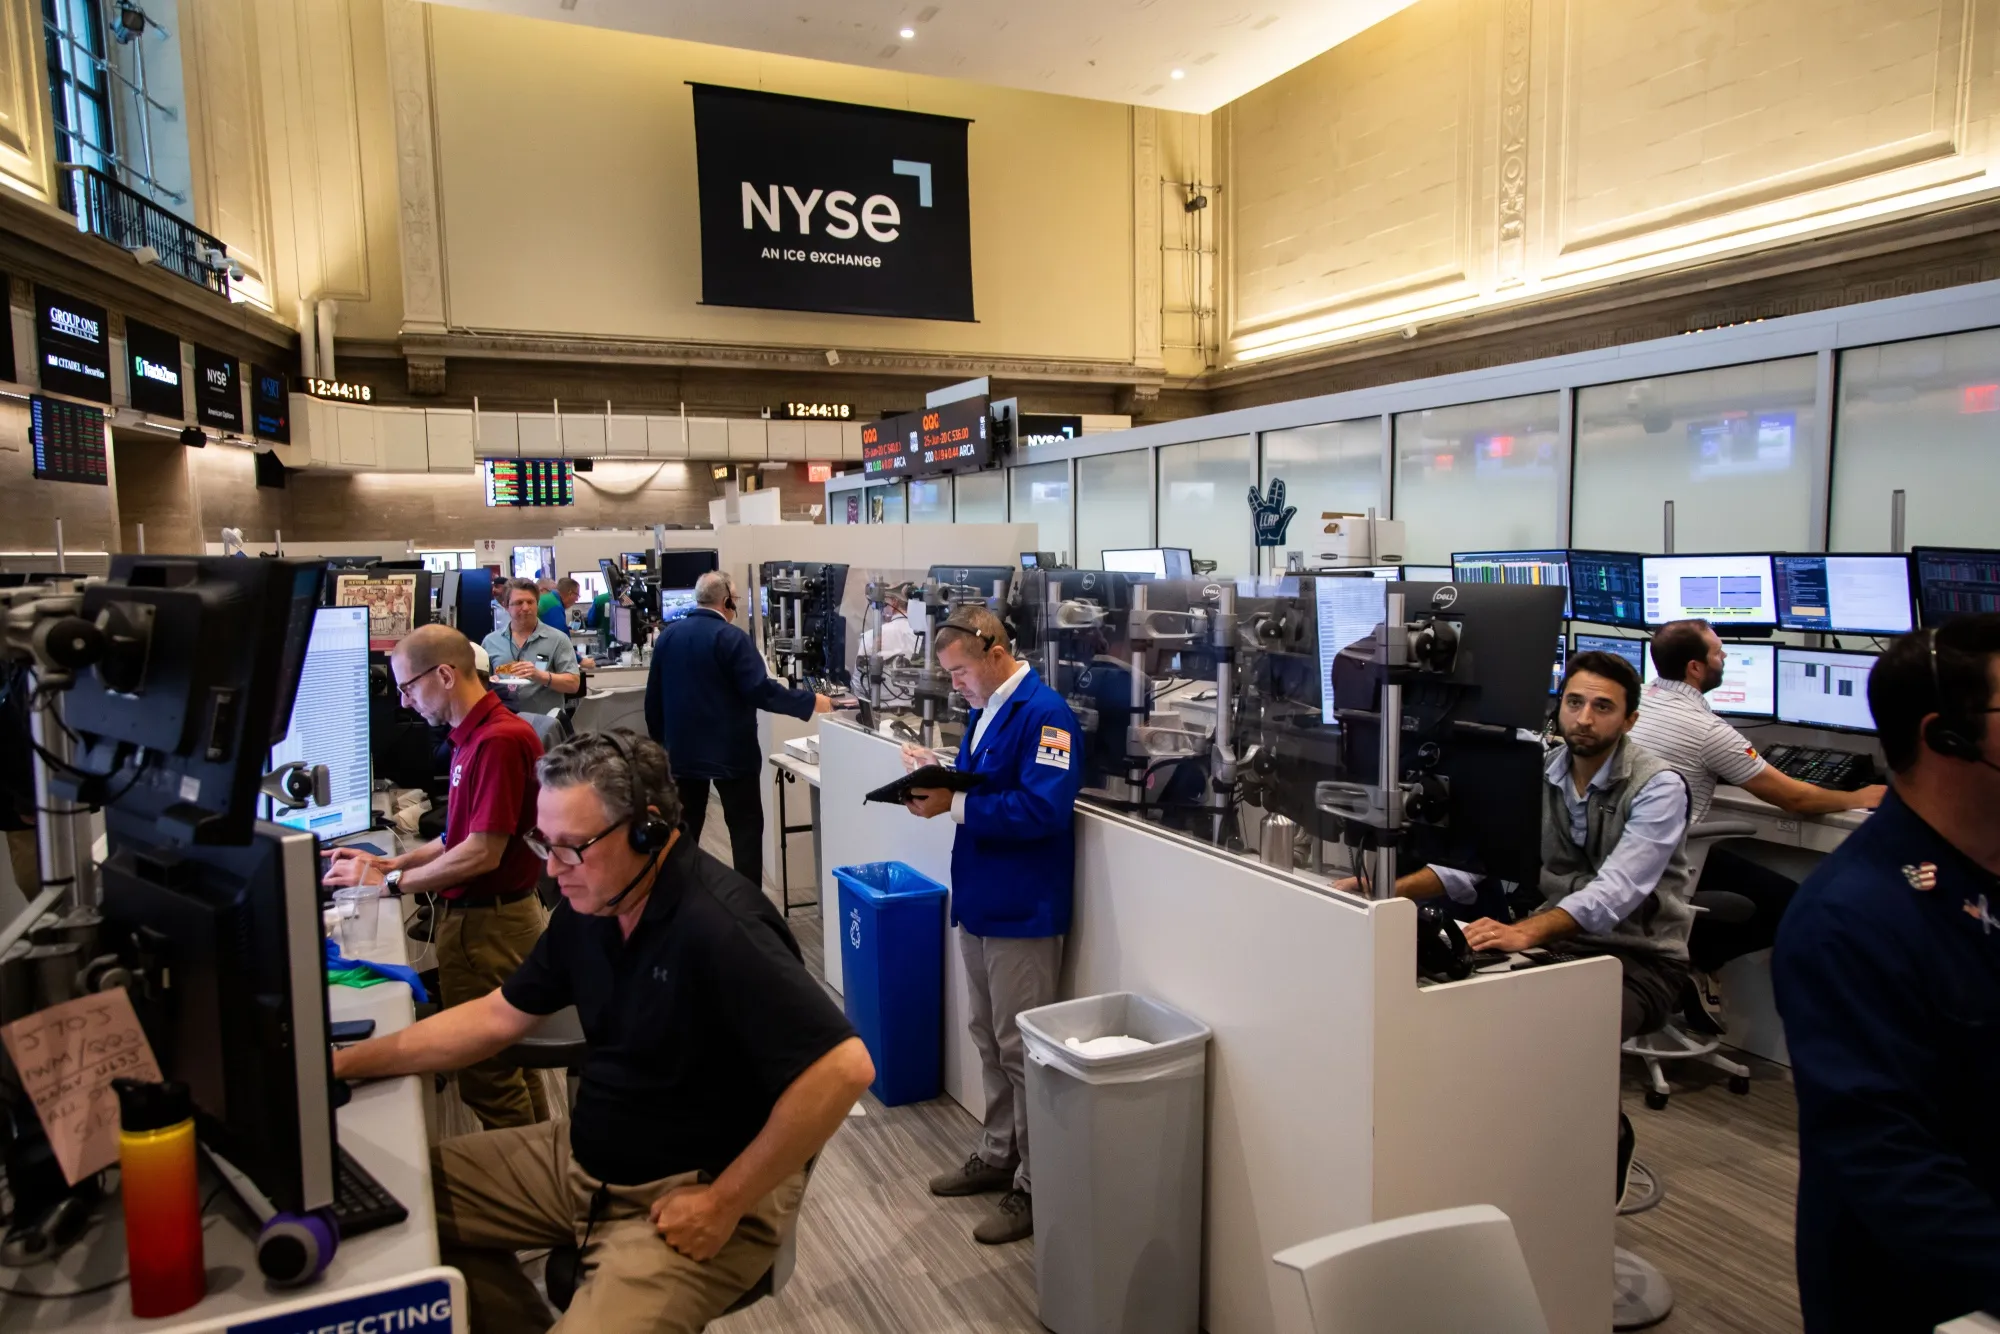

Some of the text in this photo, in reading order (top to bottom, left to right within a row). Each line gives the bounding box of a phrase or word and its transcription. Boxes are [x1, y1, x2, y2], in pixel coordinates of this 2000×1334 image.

[761, 247, 780, 260] AN
[50, 307, 99, 334] GROUP ONE
[58, 357, 105, 379] CITADEL Securities
[142, 360, 177, 385] TradeZero
[308, 378, 371, 400] 12:44:18
[788, 403, 849, 417] 12:44:18
[959, 444, 975, 457] ARCA
[1260, 514, 1280, 526] LLAP
[308, 1299, 450, 1334] ECTING
